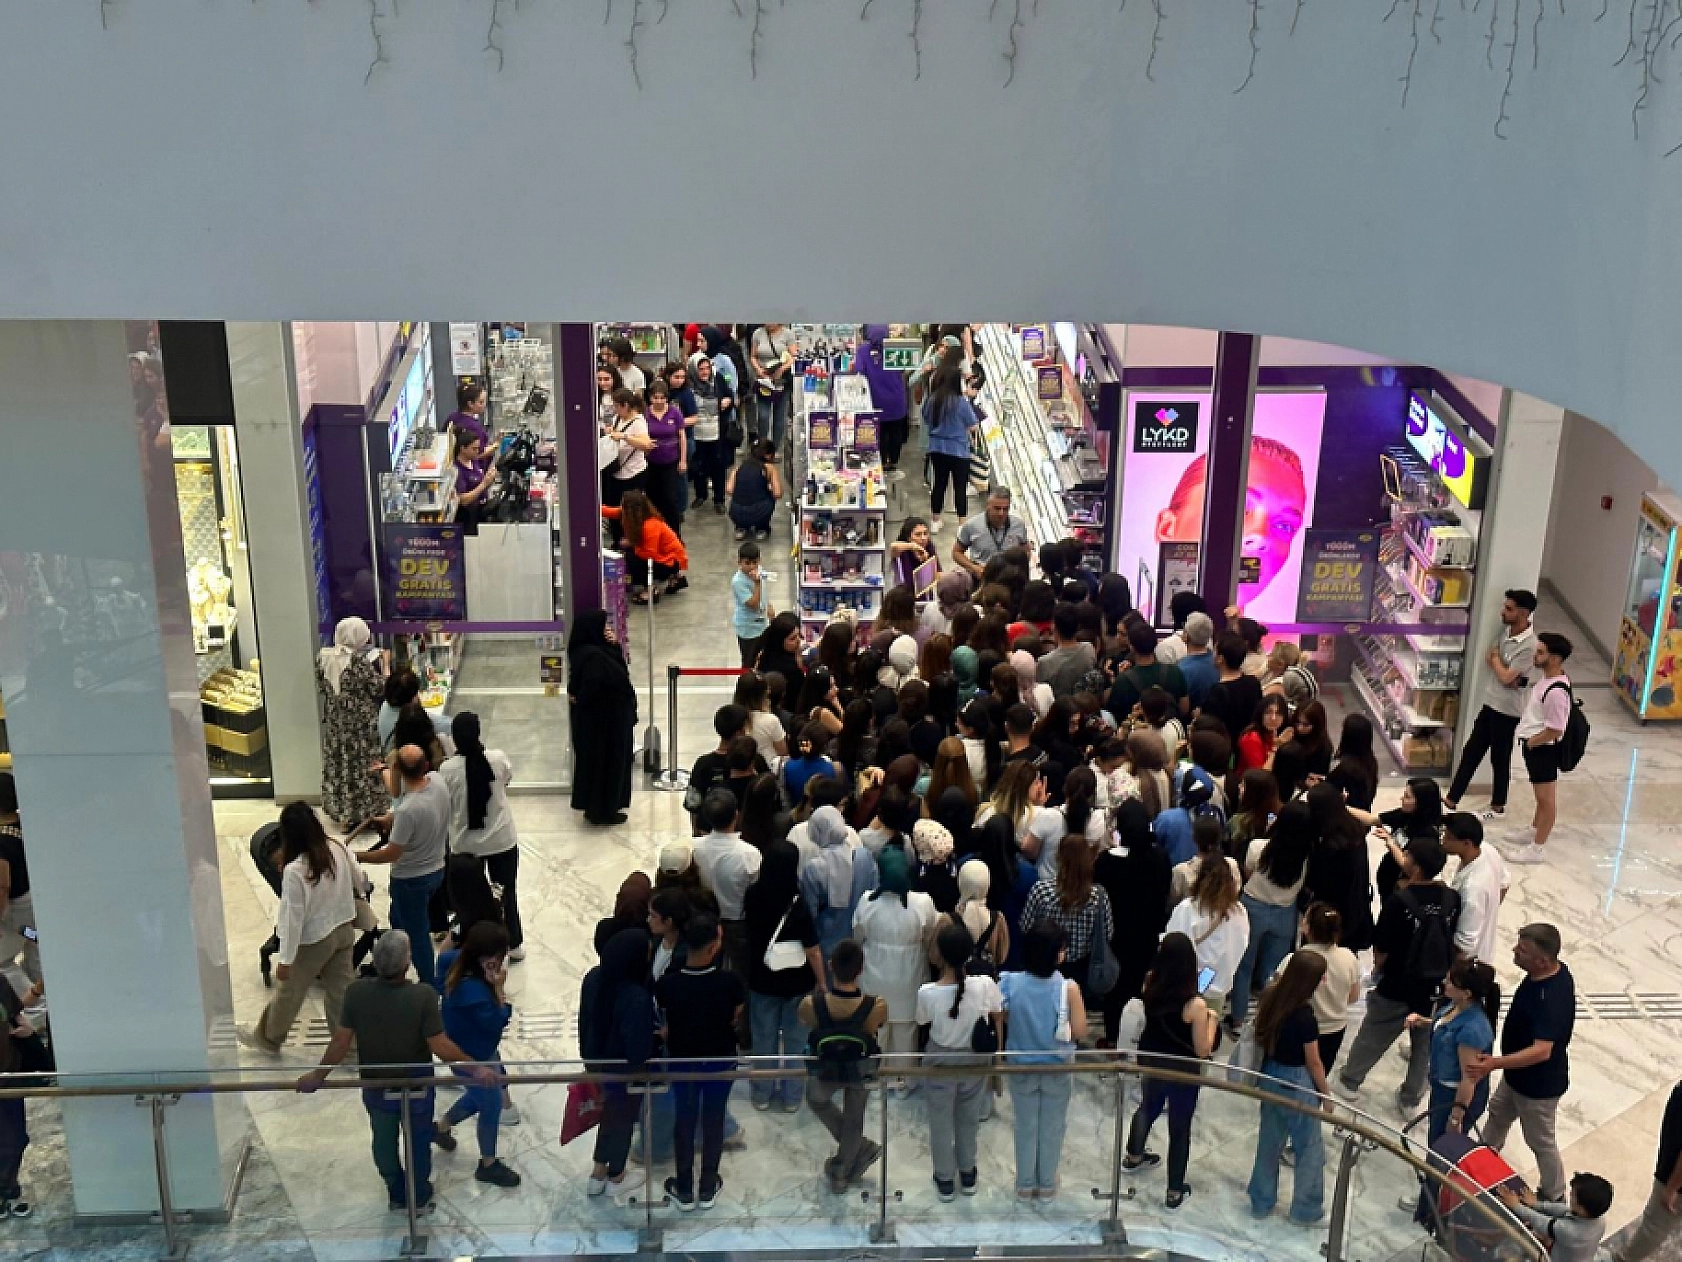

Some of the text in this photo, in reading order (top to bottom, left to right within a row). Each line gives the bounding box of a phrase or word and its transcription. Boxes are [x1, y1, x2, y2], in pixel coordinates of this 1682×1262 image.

[1142, 427, 1190, 441] LYKD
[400, 558, 450, 576] DEV
[1314, 562, 1363, 579] DEV
